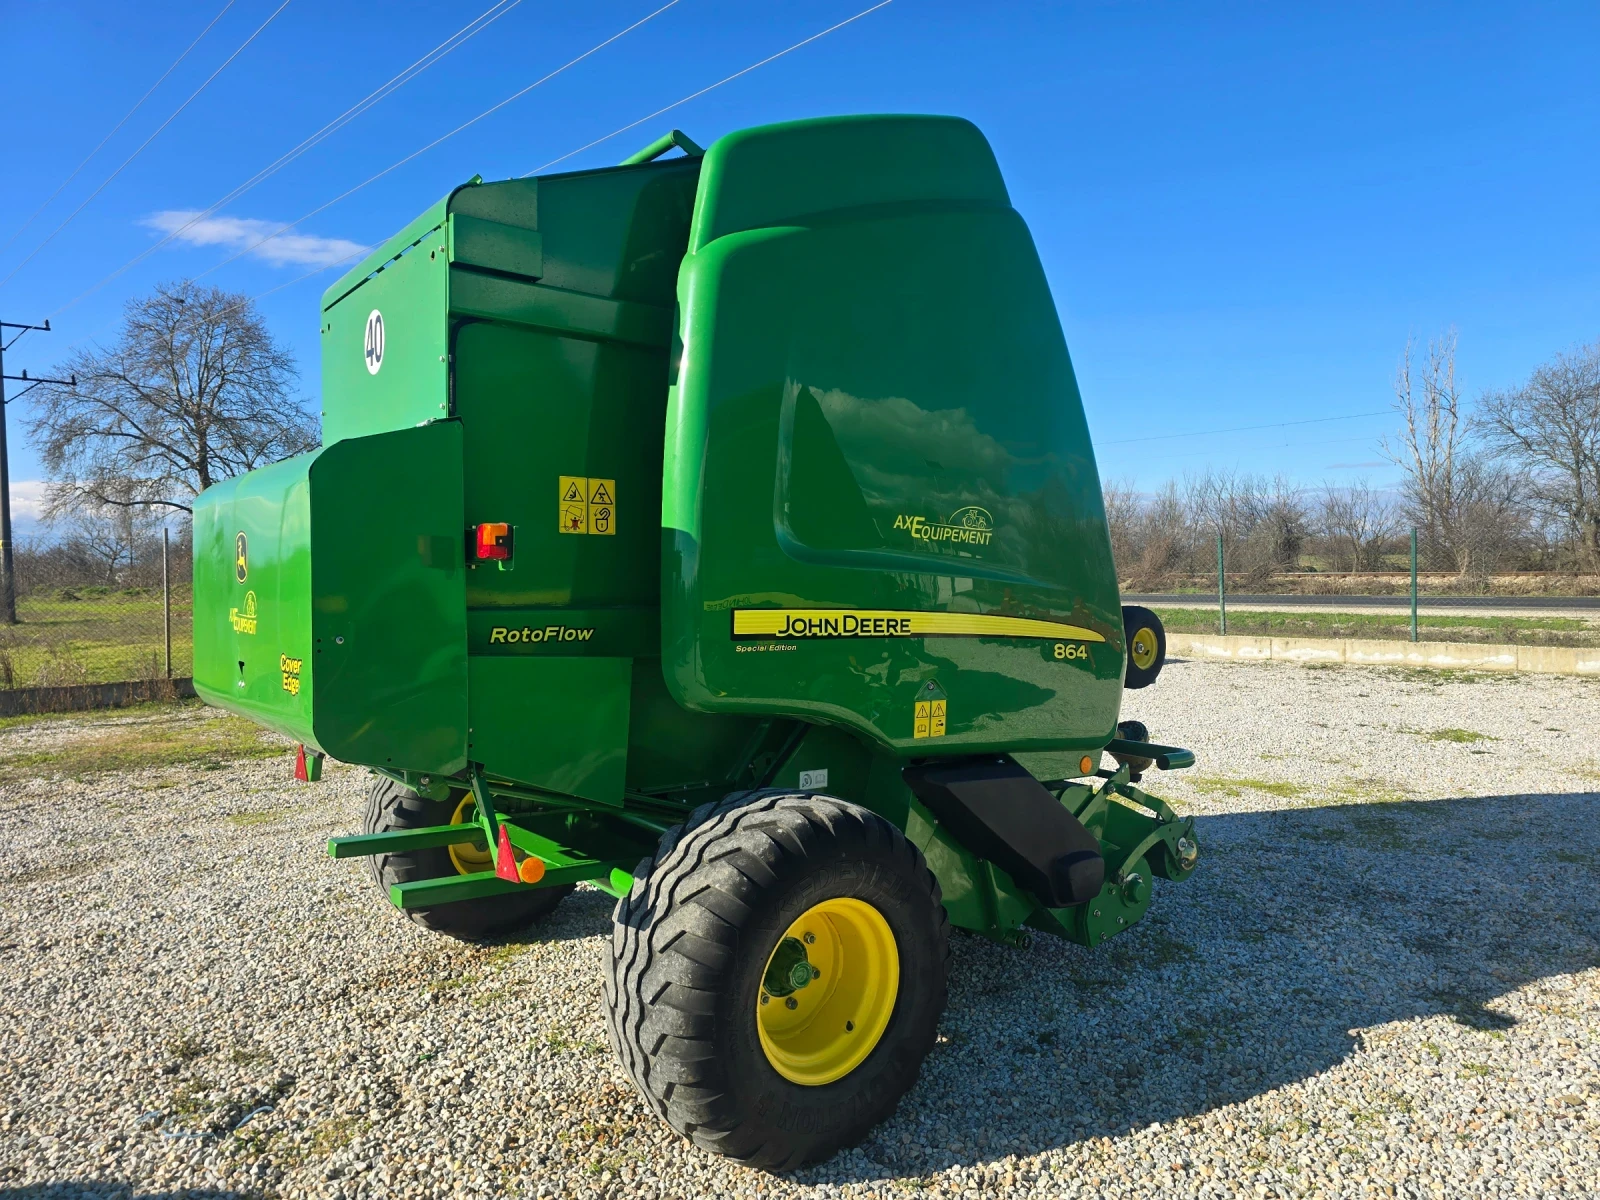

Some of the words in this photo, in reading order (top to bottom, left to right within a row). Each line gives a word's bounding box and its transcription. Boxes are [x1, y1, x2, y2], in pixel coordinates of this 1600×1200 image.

[366, 314, 383, 367] 40
[489, 626, 595, 643] RotoFlow
[777, 615, 839, 636] JOHN
[843, 615, 912, 636] DEERE
[735, 645, 767, 653] Special
[769, 644, 797, 652] Edition
[1053, 643, 1088, 660] 864
[280, 653, 302, 675] Cover
[283, 672, 300, 696] Edge
